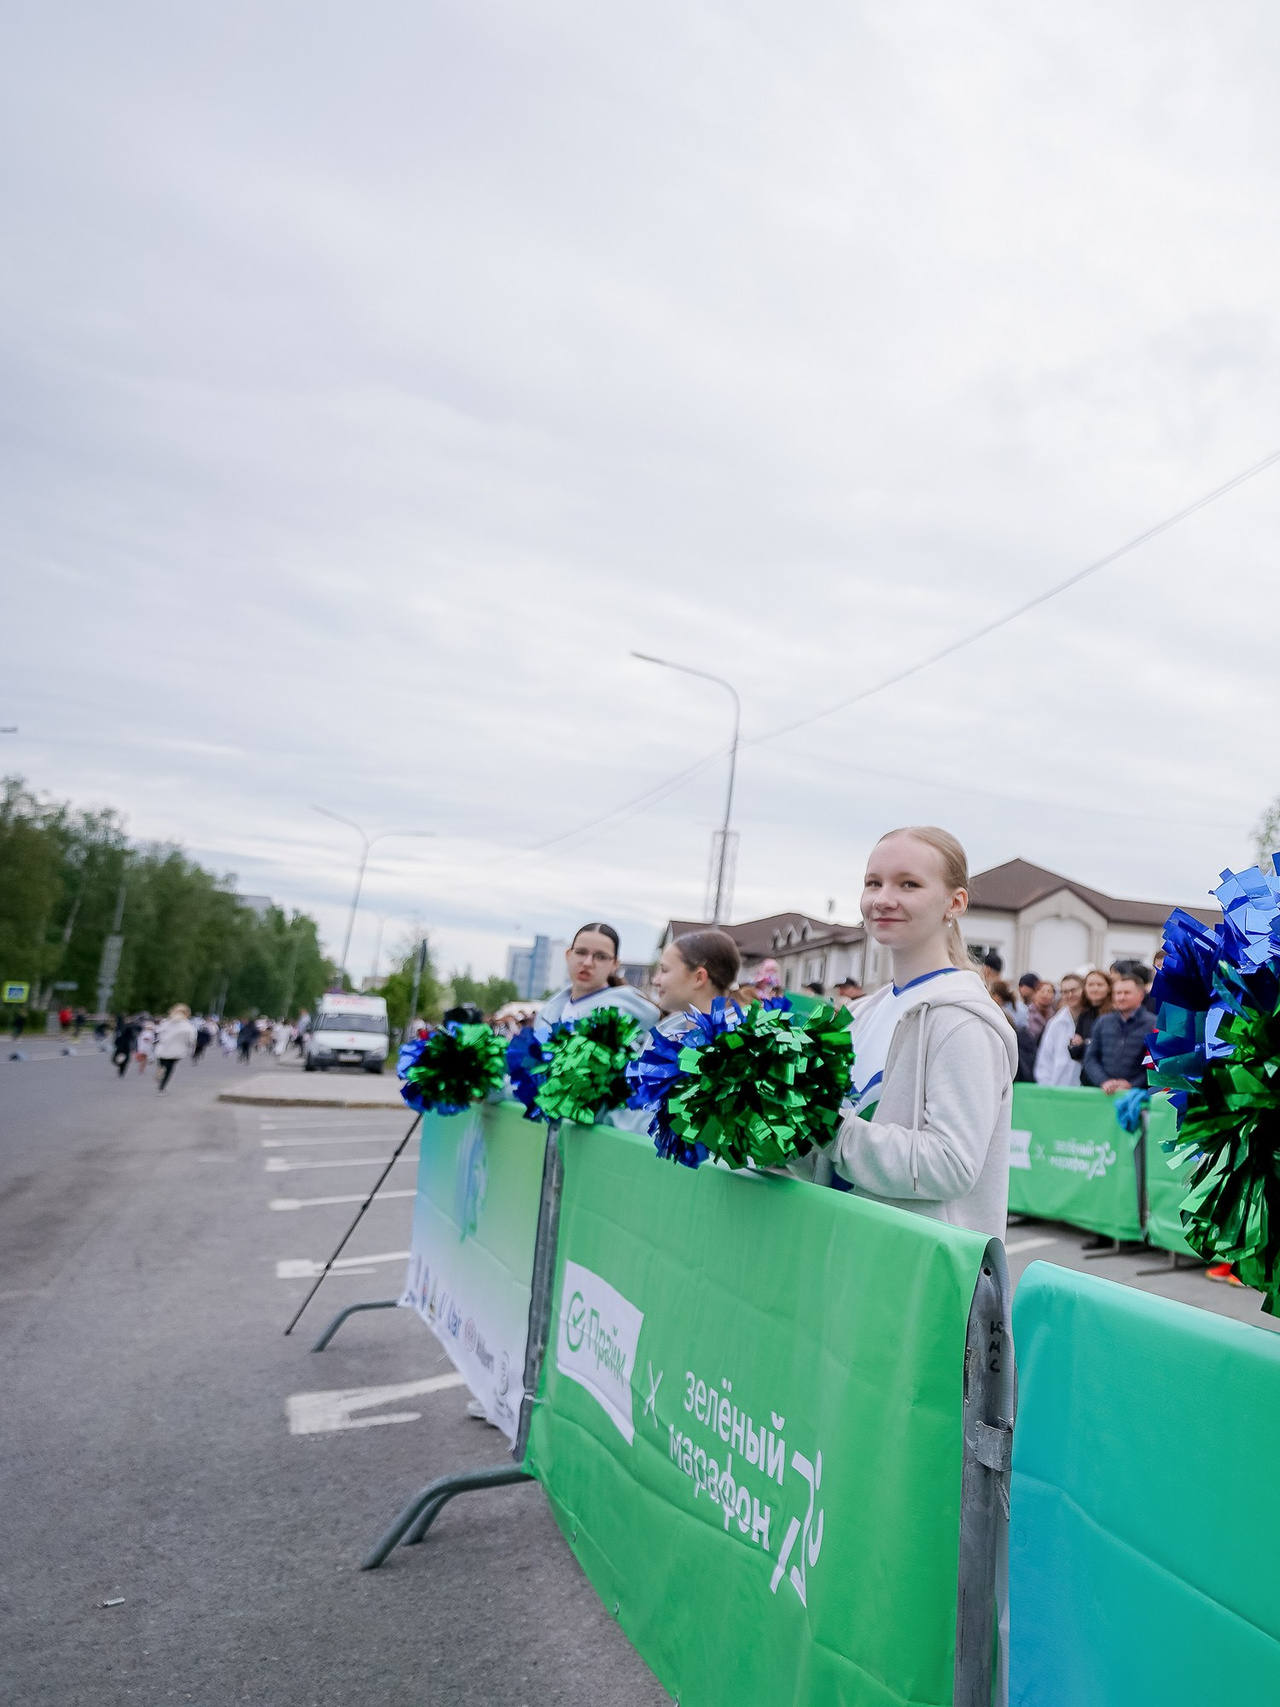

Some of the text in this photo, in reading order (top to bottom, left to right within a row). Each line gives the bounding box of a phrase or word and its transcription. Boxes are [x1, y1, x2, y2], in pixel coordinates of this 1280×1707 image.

[588, 1307, 627, 1387] Прайм
[684, 1371, 786, 1486] зелёный
[669, 1423, 771, 1551] марафон
